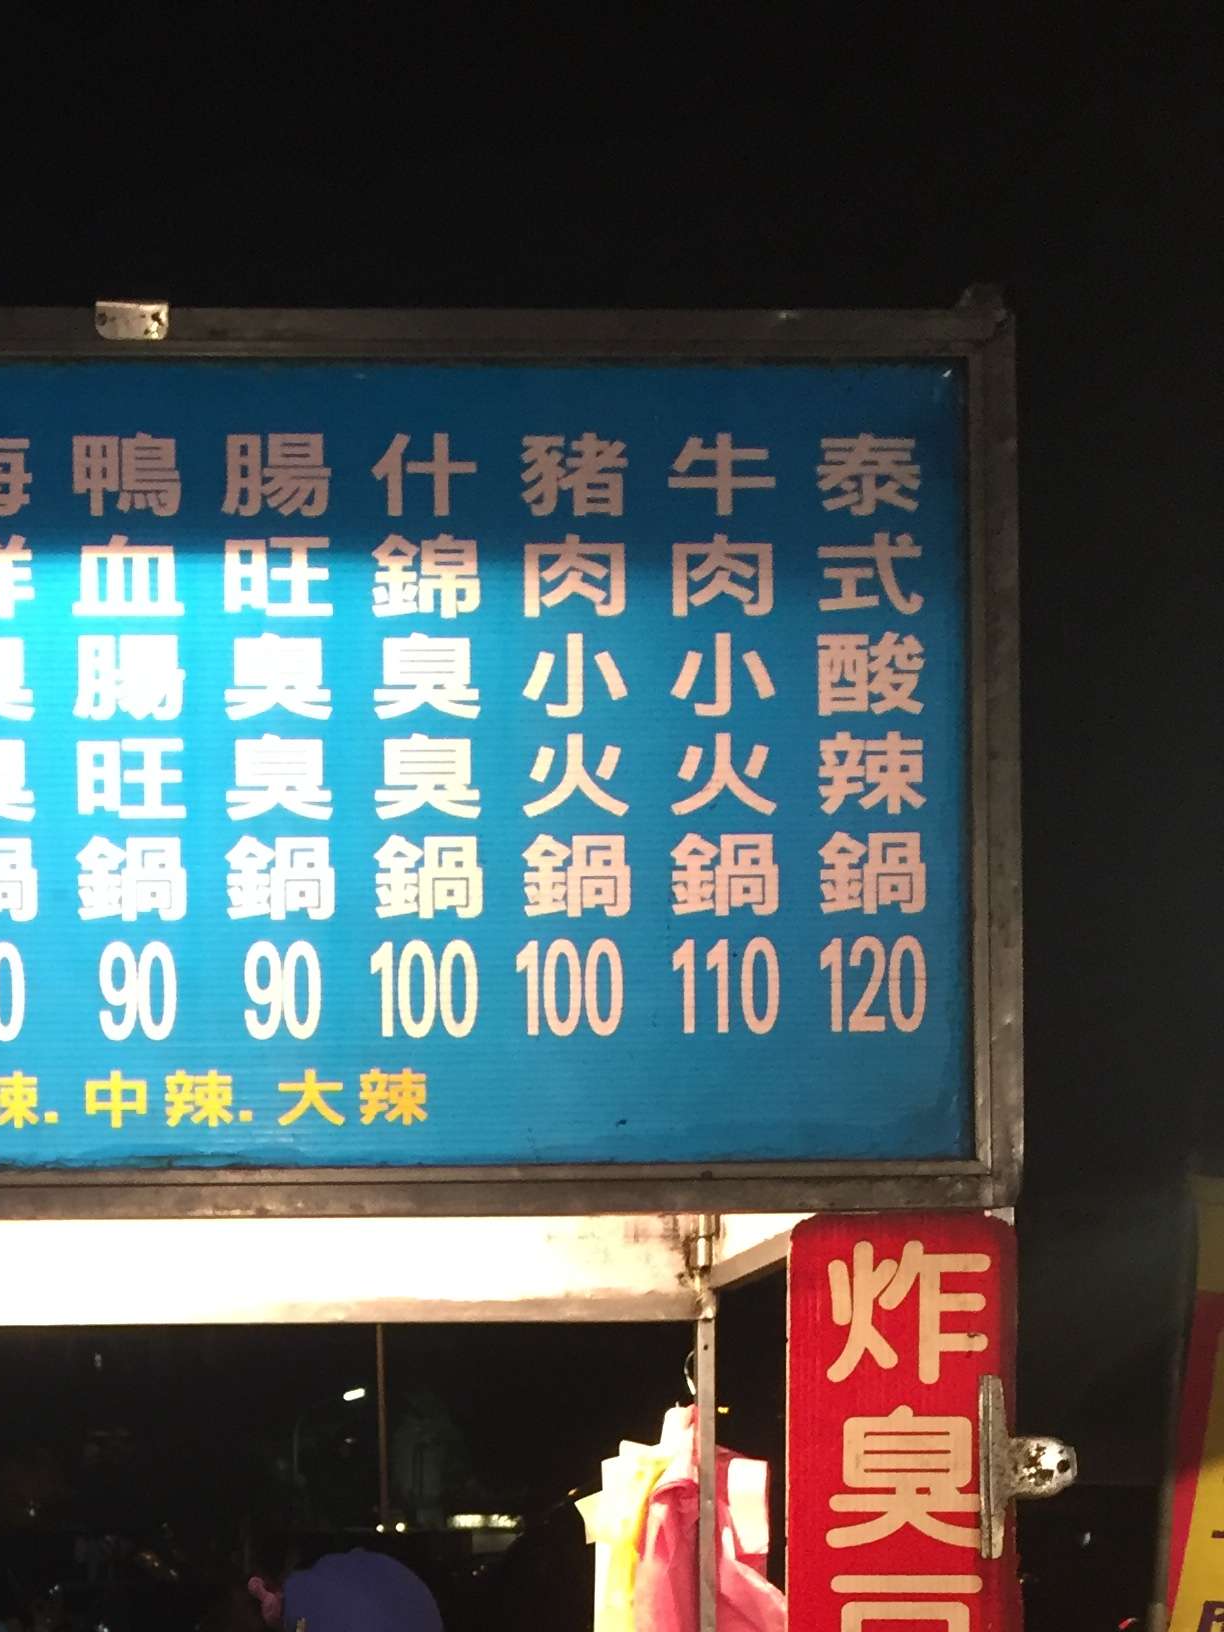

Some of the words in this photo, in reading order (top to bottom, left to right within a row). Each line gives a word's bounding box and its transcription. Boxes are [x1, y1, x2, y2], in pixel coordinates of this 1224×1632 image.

[72, 433, 187, 921] 鴨血腸旺鍋
[223, 433, 335, 920] 腸旺臭臭鍋
[372, 433, 483, 918] 什錦臭臭鍋
[521, 433, 631, 916] 豬肉小火鍋
[668, 433, 778, 915] 牛肉小火鍋
[817, 434, 926, 913] 泰式酸辣鍋
[99, 941, 177, 1041] 90
[244, 941, 321, 1040] 90
[371, 940, 478, 1038] 100
[516, 938, 623, 1036] 100
[672, 937, 779, 1035] 110
[820, 936, 927, 1032] 120
